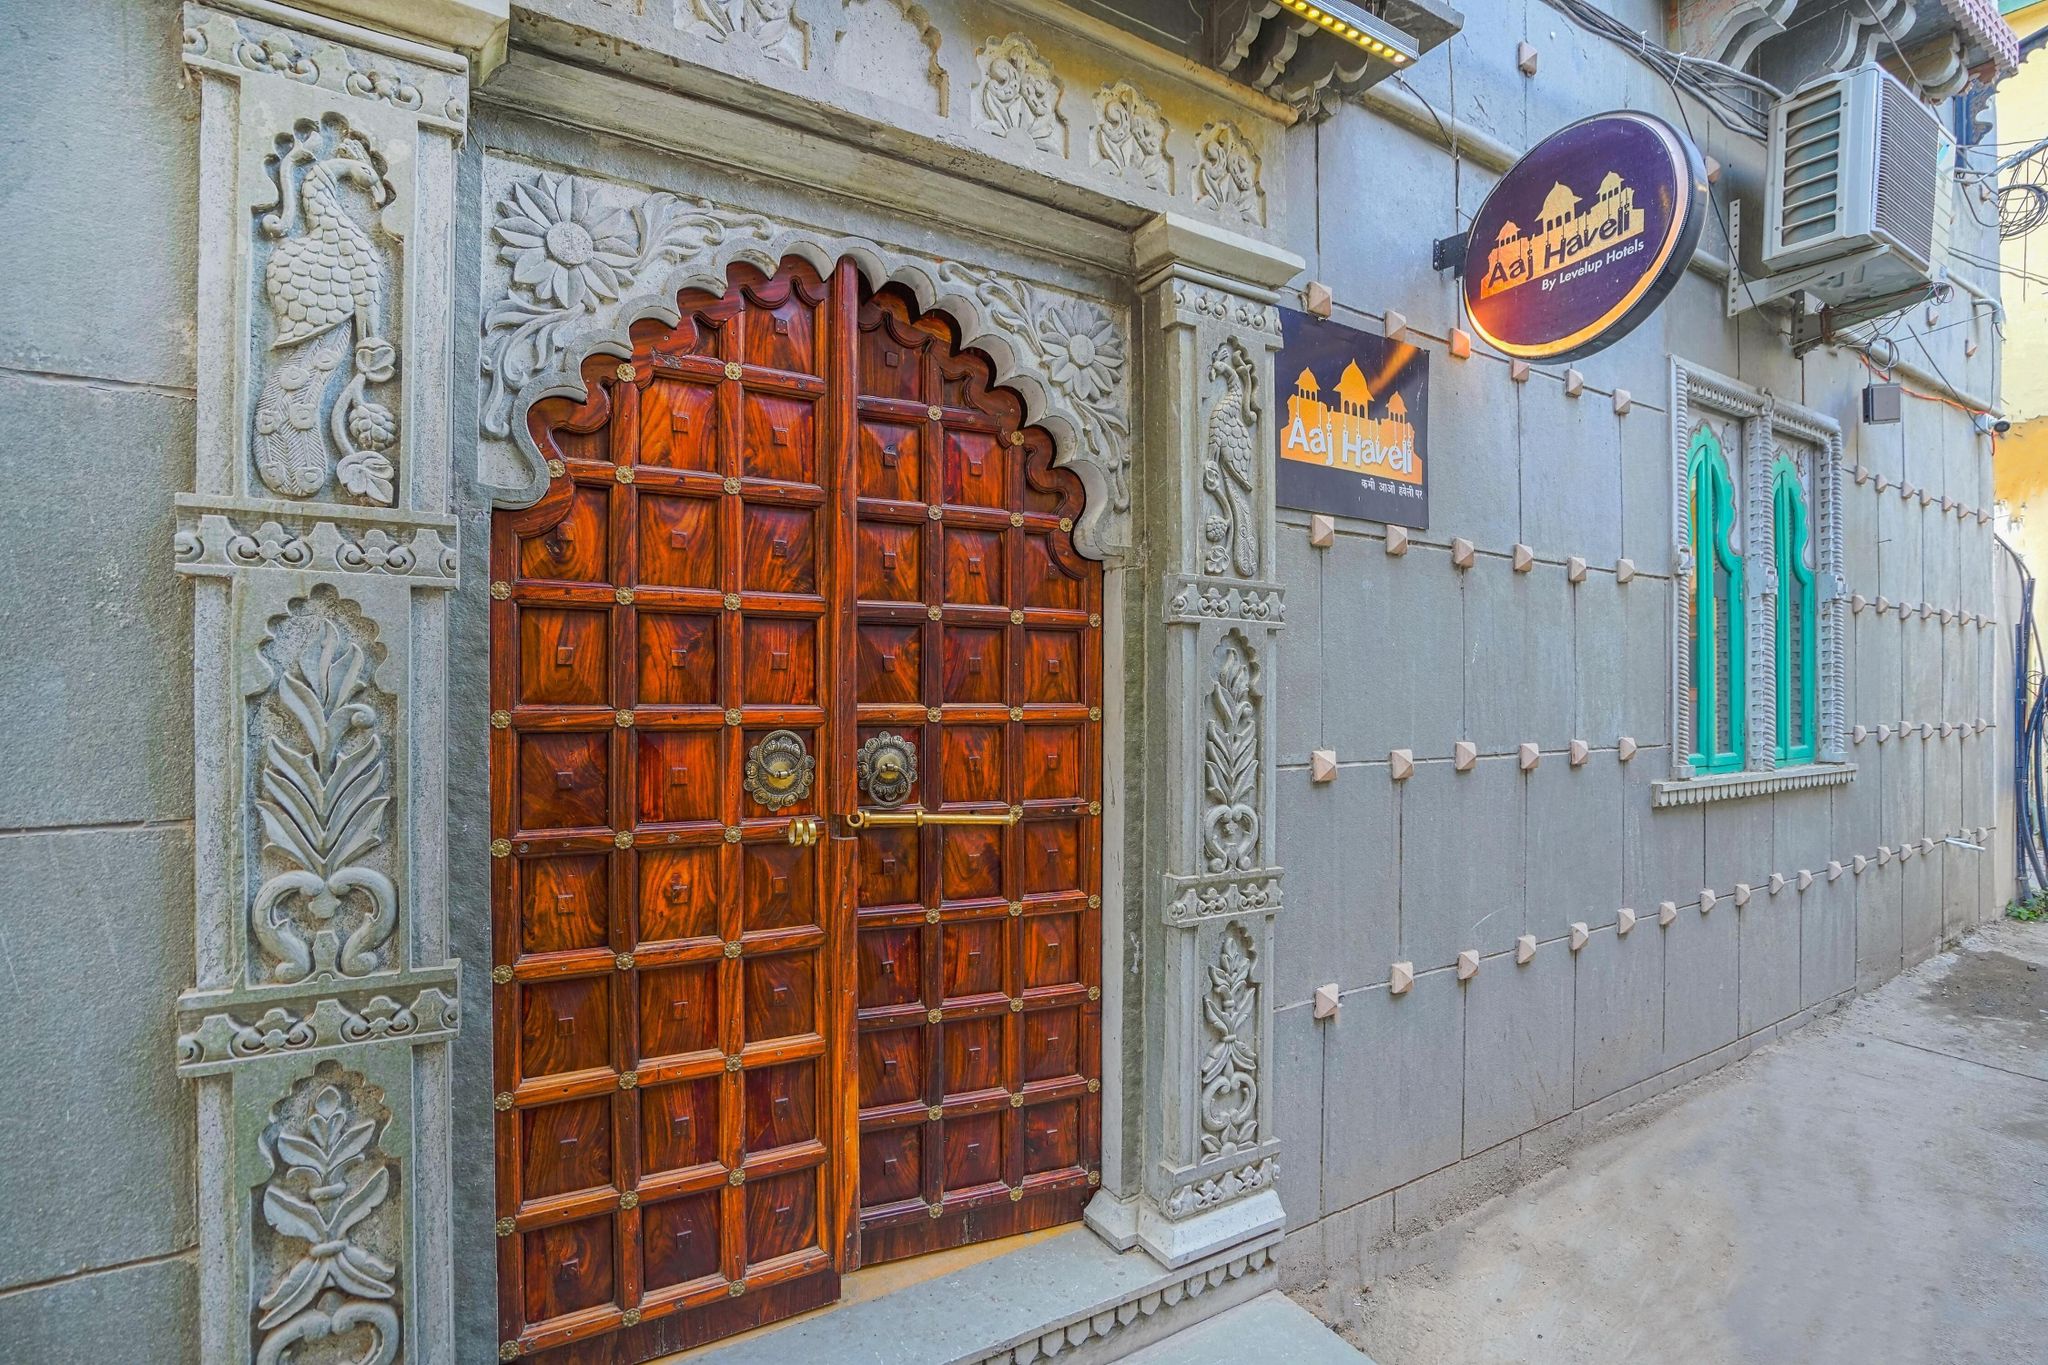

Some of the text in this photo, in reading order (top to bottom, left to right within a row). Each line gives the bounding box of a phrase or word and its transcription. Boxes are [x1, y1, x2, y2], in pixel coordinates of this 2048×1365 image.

[1488, 203, 1630, 289] Aaj Haveli
[1541, 238, 1645, 292] By Levelup Hotels
[1287, 416, 1413, 475] Aaj Haveli
